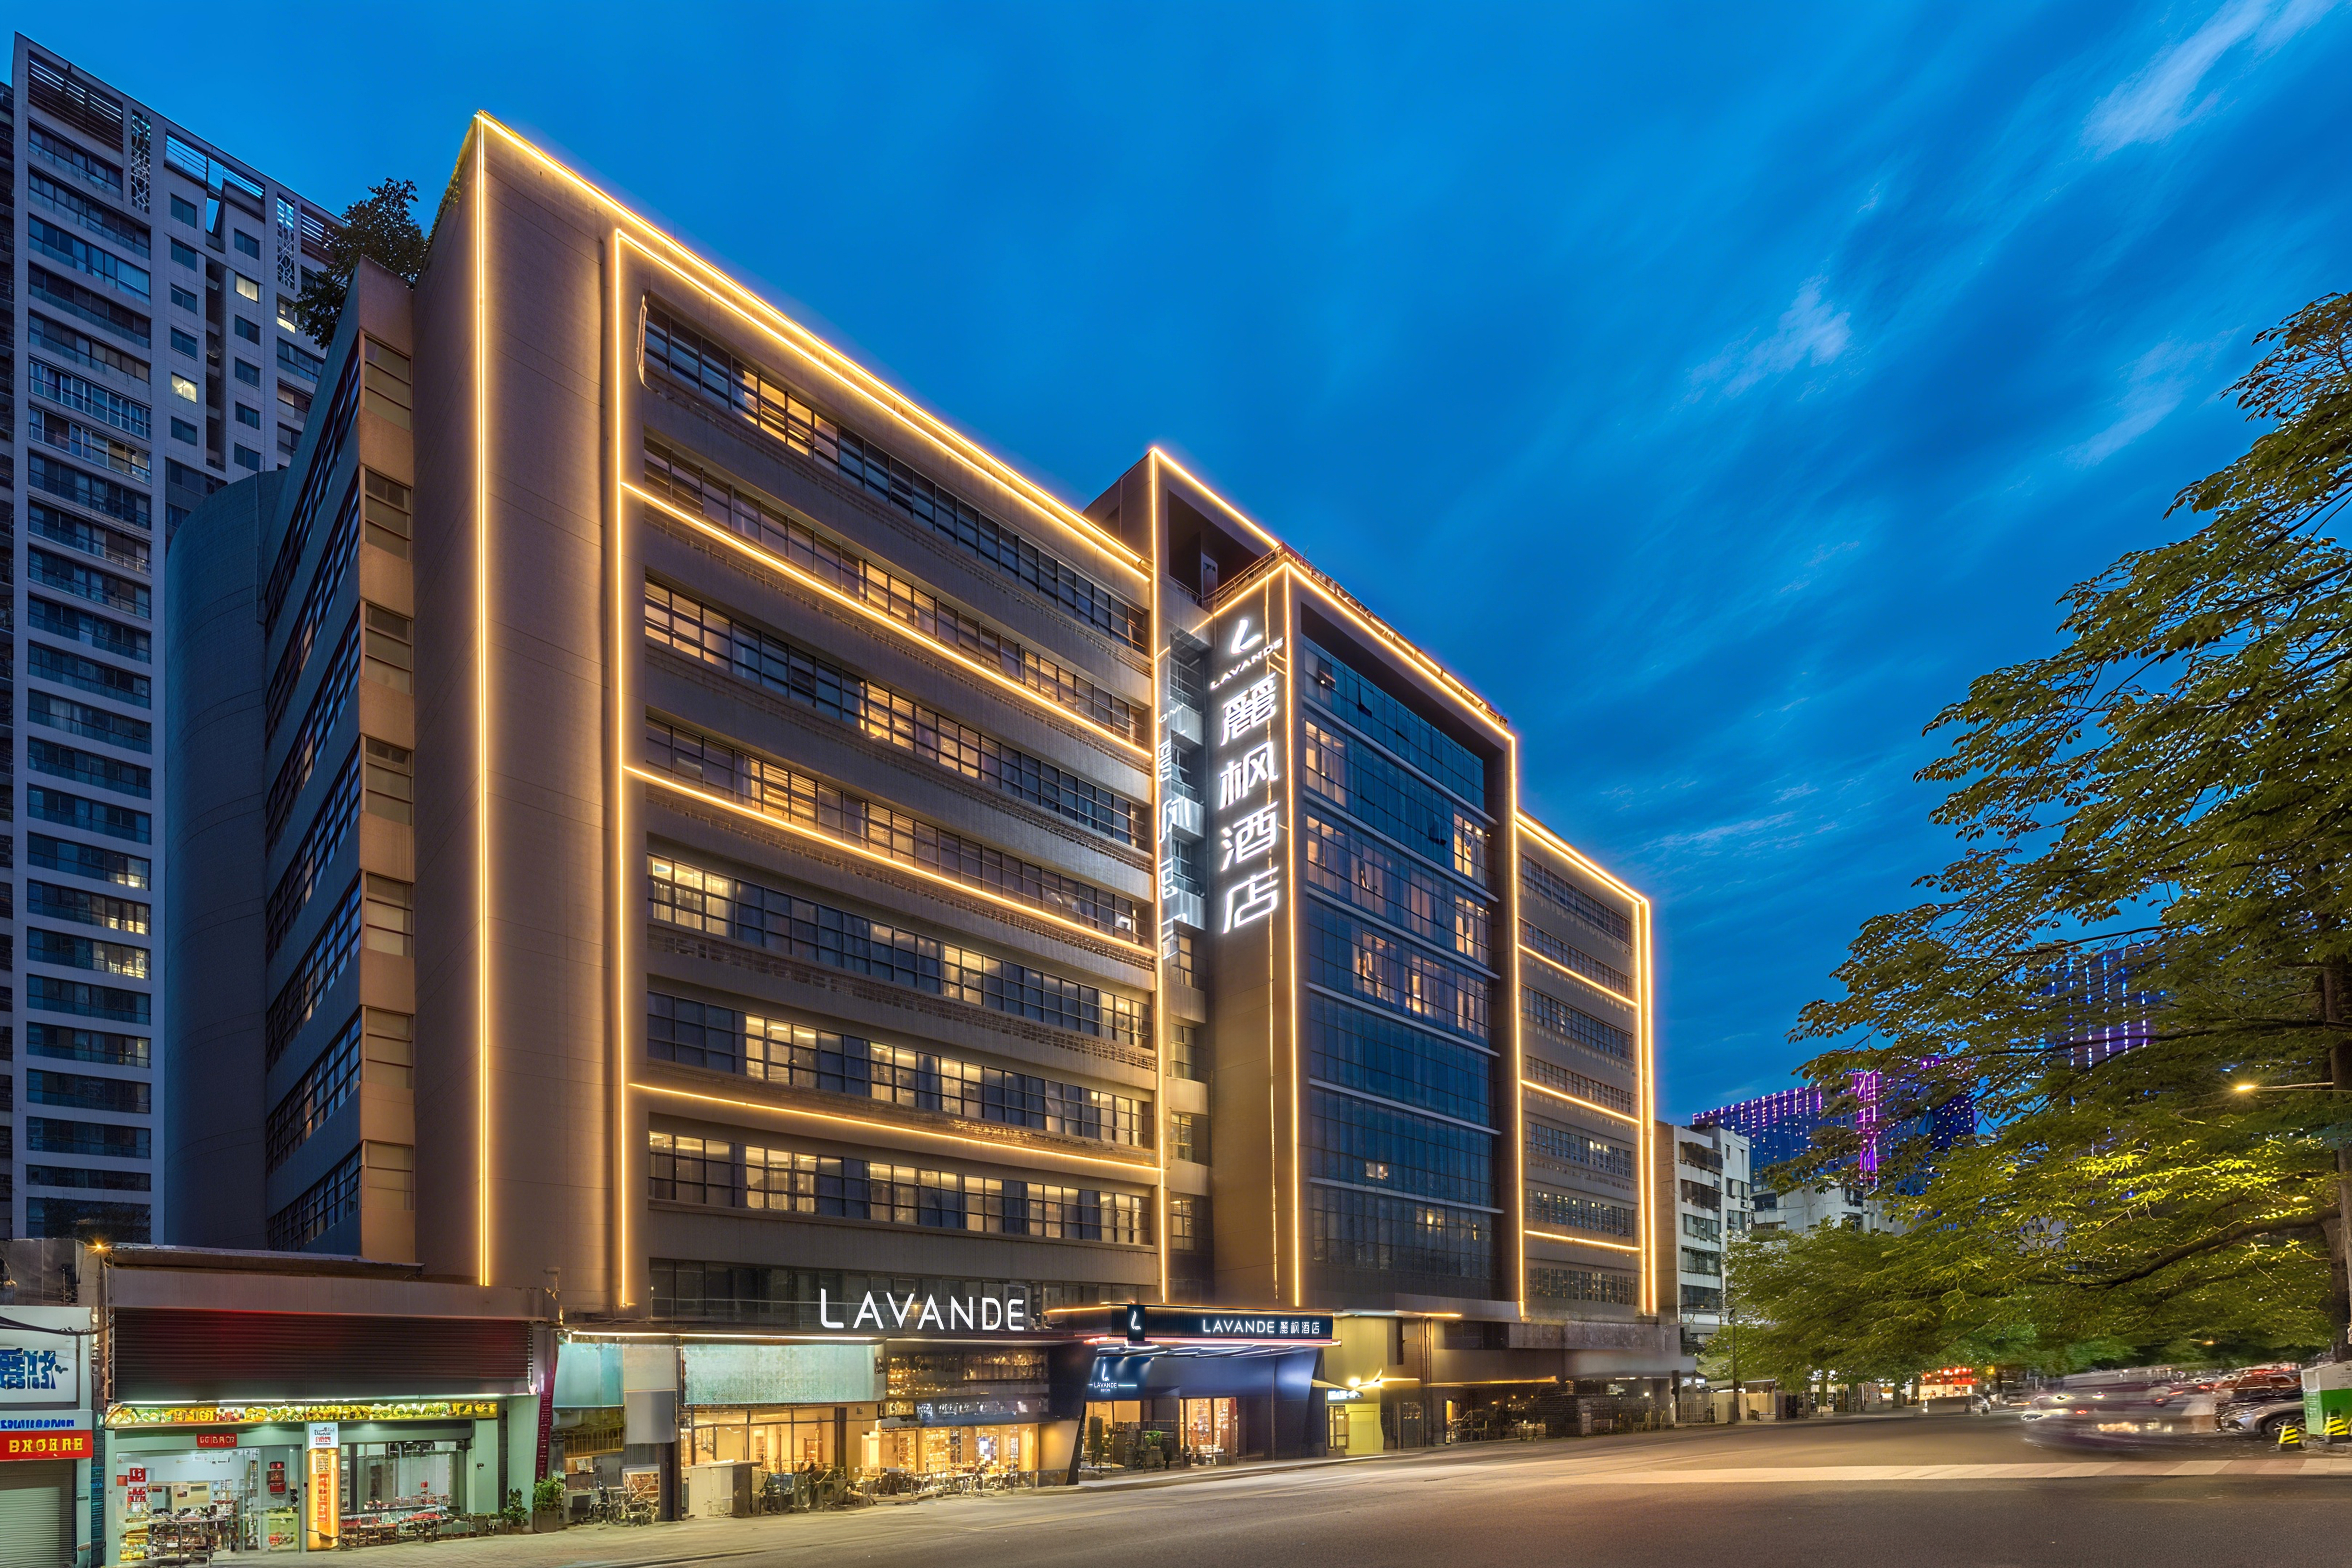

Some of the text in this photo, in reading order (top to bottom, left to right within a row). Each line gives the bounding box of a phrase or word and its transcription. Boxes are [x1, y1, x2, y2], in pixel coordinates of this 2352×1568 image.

[1210, 637, 1284, 690] LAVANDE
[1220, 671, 1279, 934] 麗枫酒店
[820, 1288, 1025, 1331] LAVANDE
[1203, 1319, 1275, 1333] LAVANDE
